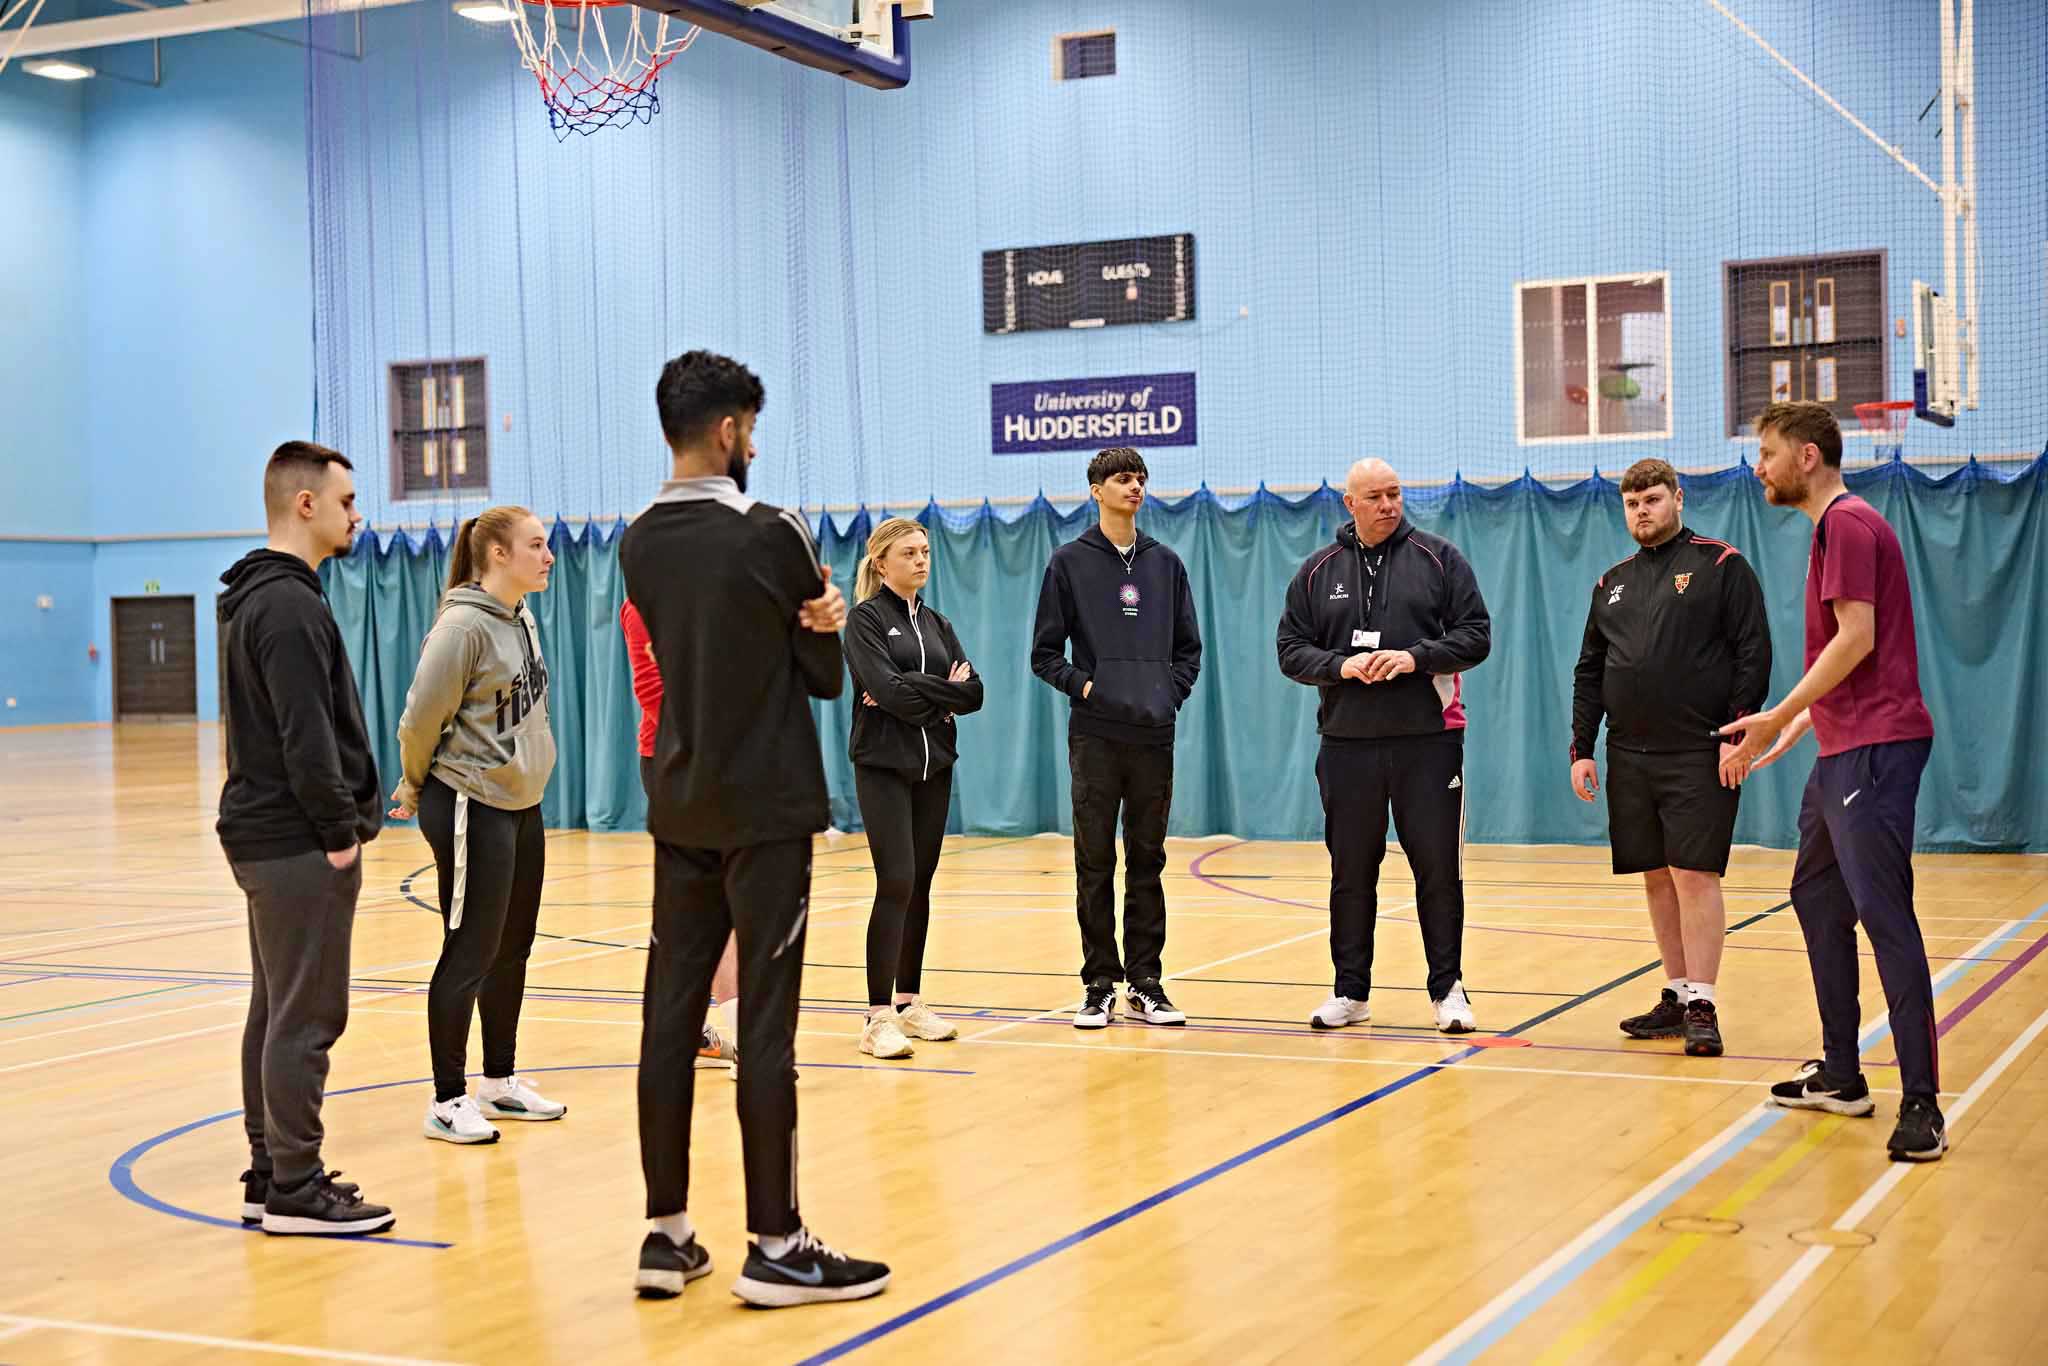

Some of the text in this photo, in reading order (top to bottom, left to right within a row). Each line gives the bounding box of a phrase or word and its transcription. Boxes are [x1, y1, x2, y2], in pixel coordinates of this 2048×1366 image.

[1026, 269, 1064, 286] HOME
[1102, 262, 1151, 280] GUESTS
[1034, 386, 1153, 413] University of
[1004, 405, 1182, 443] HUDDERSFIELD
[1610, 584, 1625, 595] JE
